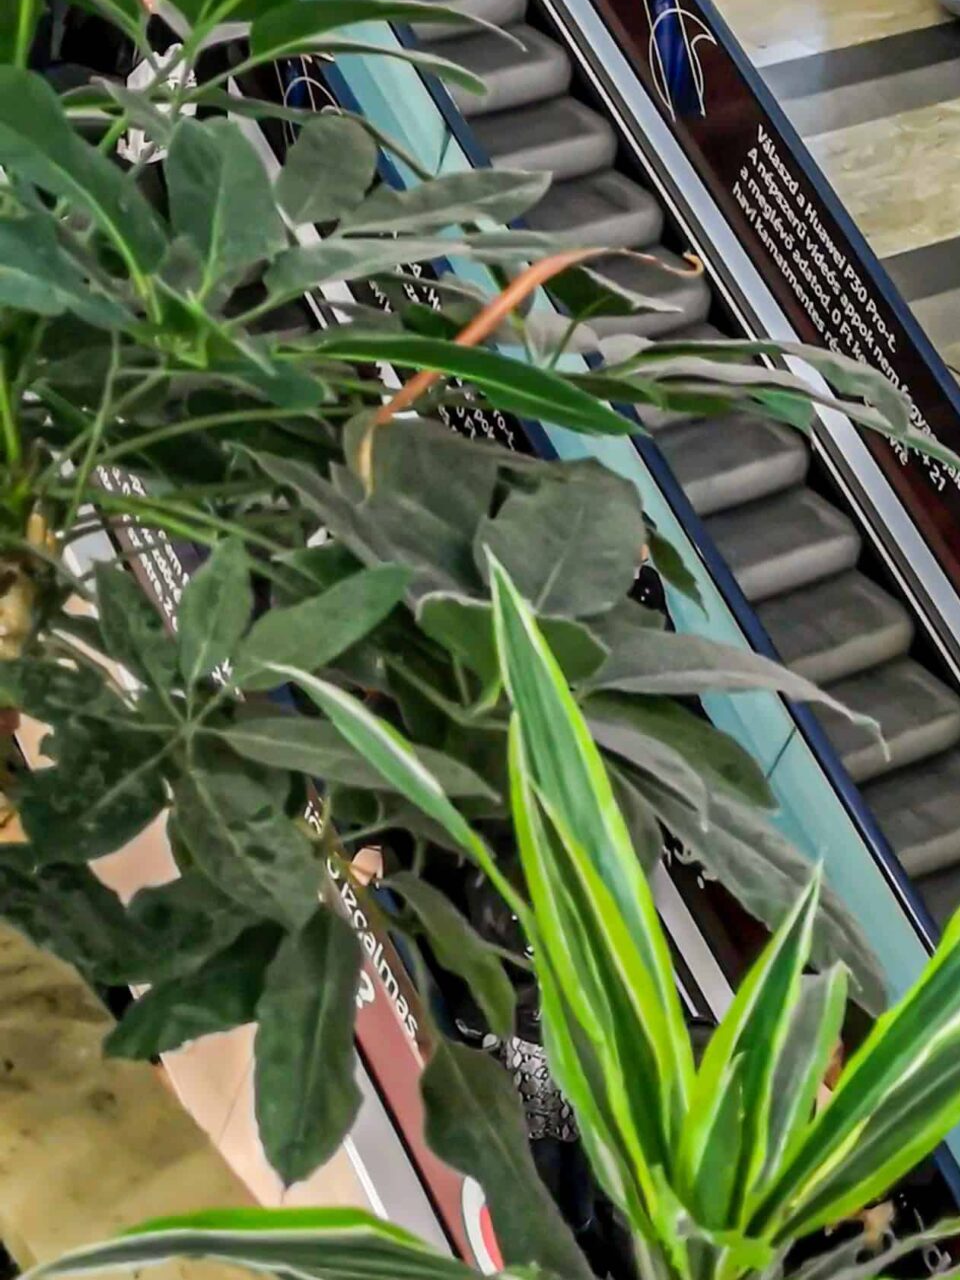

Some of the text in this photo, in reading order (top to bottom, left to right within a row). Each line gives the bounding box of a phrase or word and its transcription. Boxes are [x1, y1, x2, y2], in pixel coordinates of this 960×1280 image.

[732, 181, 825, 334] havi kamatmentes
[740, 166, 749, 182] a
[747, 178, 796, 251] meglévő
[839, 325, 855, 347] Ft
[747, 147, 759, 166] A
[805, 236, 842, 294] videós
[839, 293, 874, 350] appok
[873, 346, 900, 389] nem
[757, 124, 799, 196] Válaszd
[796, 194, 806, 208] a
[804, 203, 846, 270] Huawei
[843, 263, 868, 304] P30
